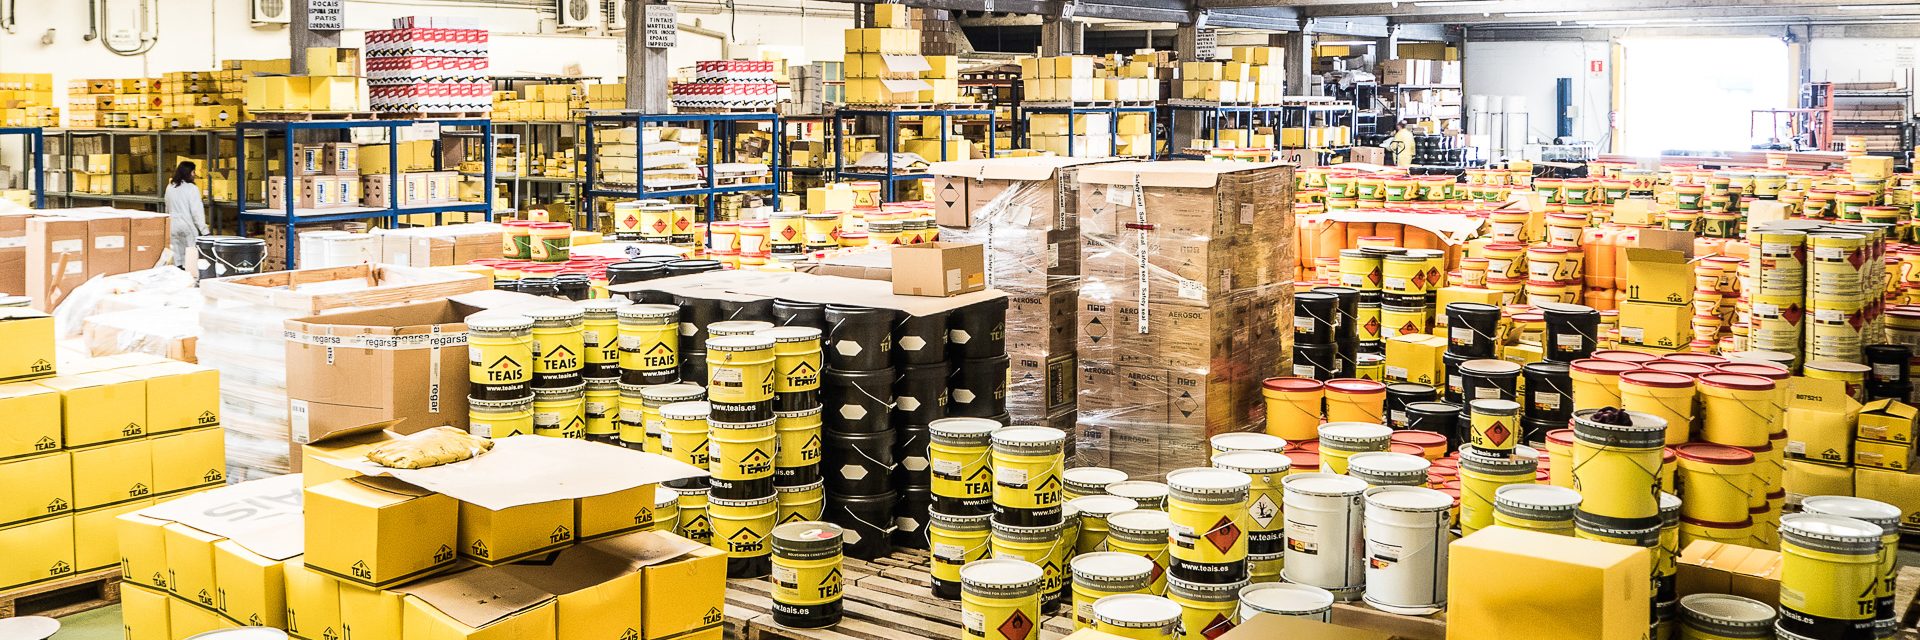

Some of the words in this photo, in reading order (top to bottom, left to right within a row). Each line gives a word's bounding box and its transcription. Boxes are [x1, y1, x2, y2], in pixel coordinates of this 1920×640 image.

[1013, 297, 1042, 305] AEROSOL
[1119, 307, 1152, 316] AEROL
[1168, 310, 1203, 320] AEROSOL
[366, 337, 398, 348] regarsa
[544, 357, 577, 370] TEAIS
[644, 354, 675, 367] TEAIS
[31, 363, 52, 373] TEAIS
[1084, 366, 1116, 377] AEROSOL
[488, 369, 523, 382] TEAIS
[787, 375, 817, 387] TEAIS
[1128, 372, 1160, 382] AEROSOL
[486, 384, 524, 393] www.teais.es
[430, 384, 439, 412] regar
[712, 403, 756, 412] www.teais.es
[198, 416, 216, 425] TEAIS
[122, 427, 142, 437] TEAIS
[35, 441, 56, 451] TEAIS
[1822, 453, 1841, 461] TEAIS
[739, 460, 771, 474] TEAIS
[204, 473, 222, 483] TEAIS
[129, 487, 149, 497] TEAIS
[47, 502, 68, 512] TEAIS
[634, 513, 653, 525] TEAIS
[550, 531, 571, 544] TEAIS
[728, 540, 763, 553] TEAIS
[433, 550, 453, 564] TEAIS
[472, 546, 489, 559] TEAIS
[50, 564, 70, 575] TEAIS
[1181, 563, 1229, 572] www.teais.es
[352, 567, 371, 580] TEAIS
[153, 578, 166, 588] TEAIS
[198, 595, 213, 606] TEAIS
[703, 613, 722, 625] TEAIS
